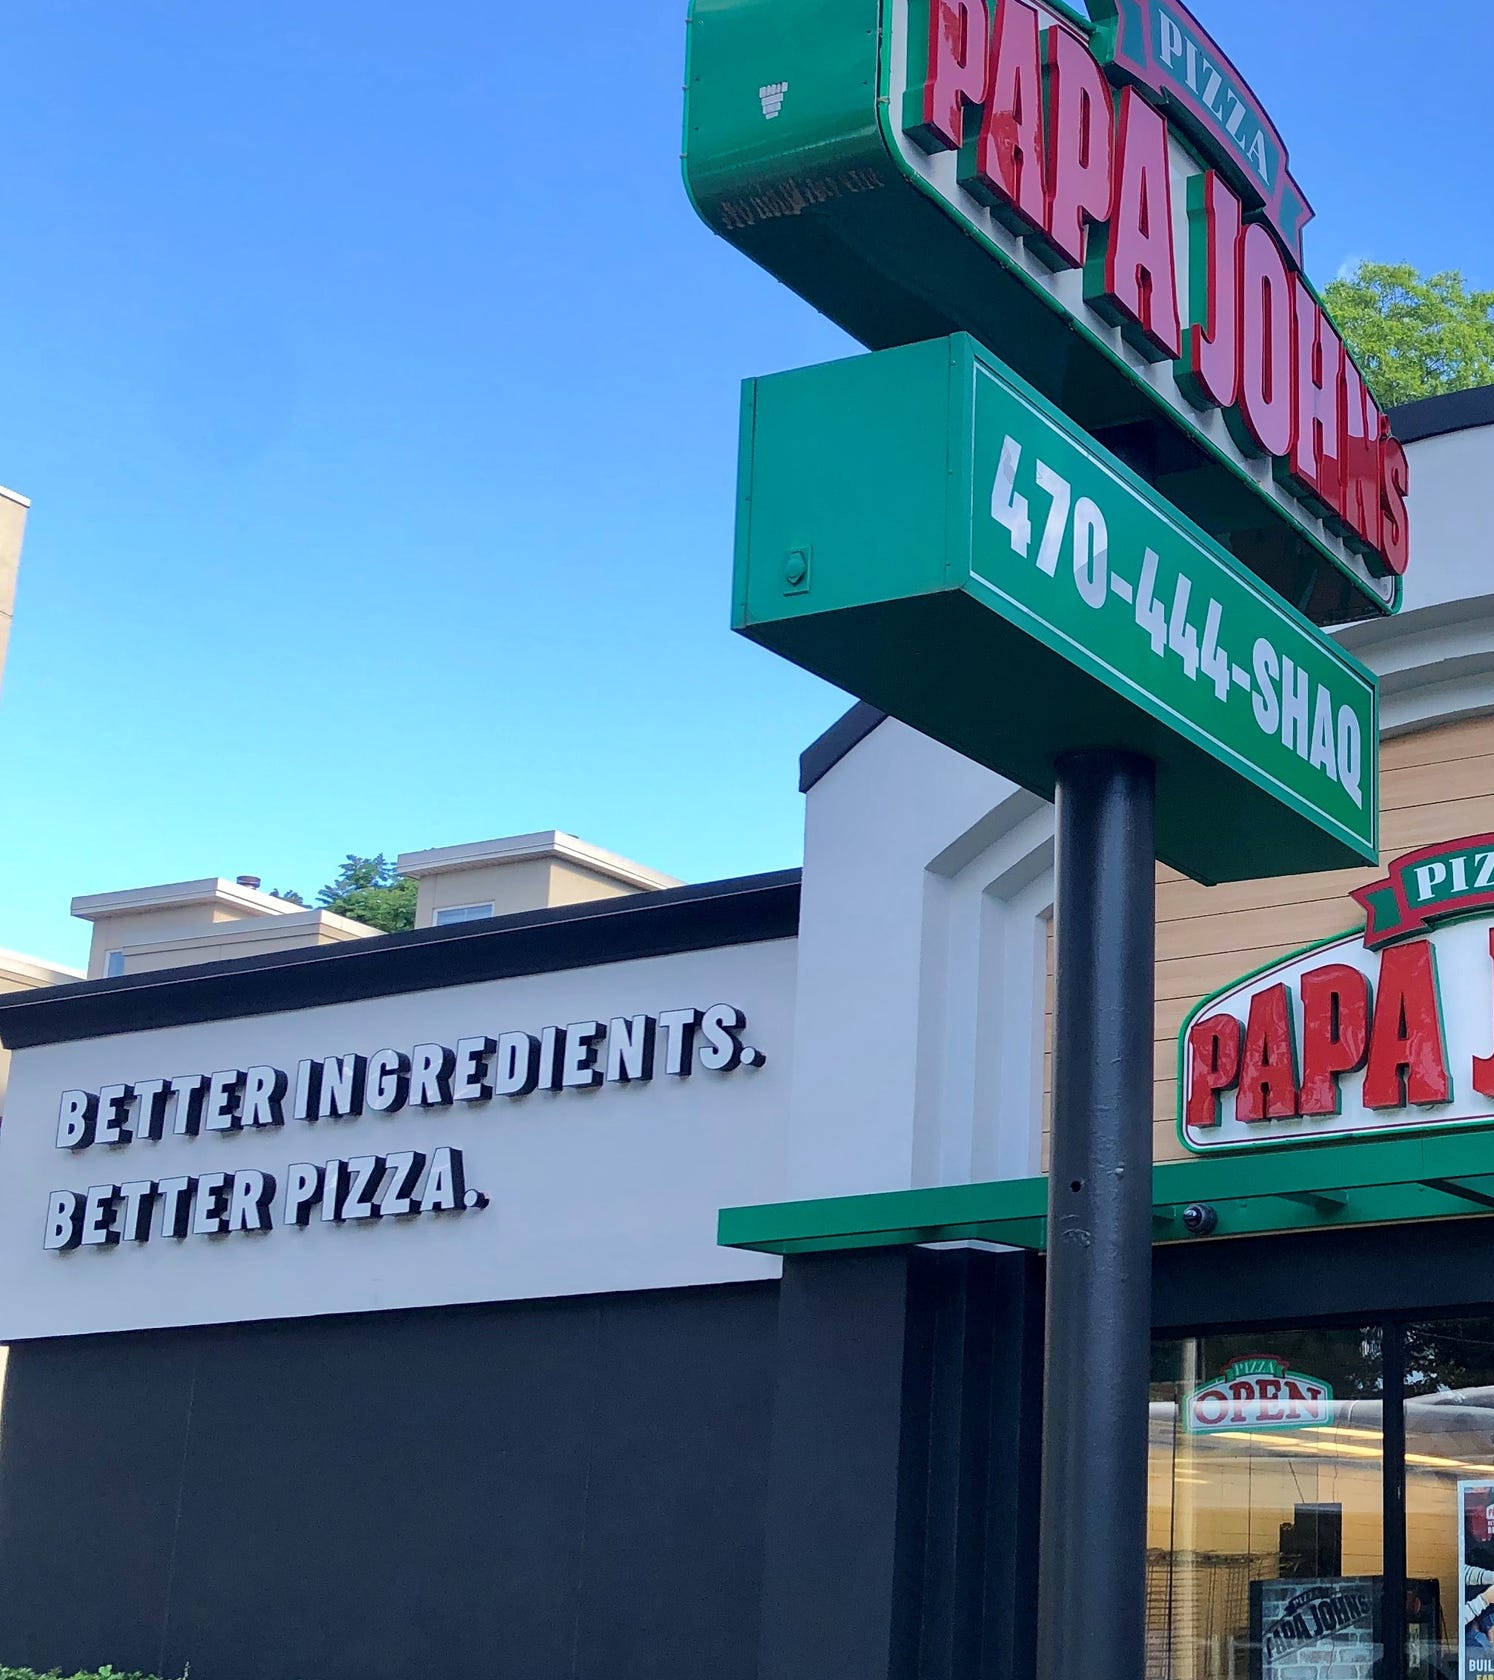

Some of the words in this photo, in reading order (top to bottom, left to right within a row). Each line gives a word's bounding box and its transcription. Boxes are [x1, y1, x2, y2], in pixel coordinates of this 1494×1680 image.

[1159, 8, 1270, 186] PIZZA
[924, 0, 1181, 359] PAPA
[1191, 169, 1409, 577] JOHN'S
[990, 434, 1362, 811] 470-444-SHAQ
[56, 1064, 288, 1150] BETTER
[293, 1003, 767, 1122] INGREDIENTS.
[1186, 938, 1454, 1129] PAPA
[43, 1168, 276, 1251] BETTER
[284, 1146, 490, 1227] PIZZA.
[1193, 1378, 1322, 1425] OPEN
[1233, 1359, 1275, 1376] PIZZA
